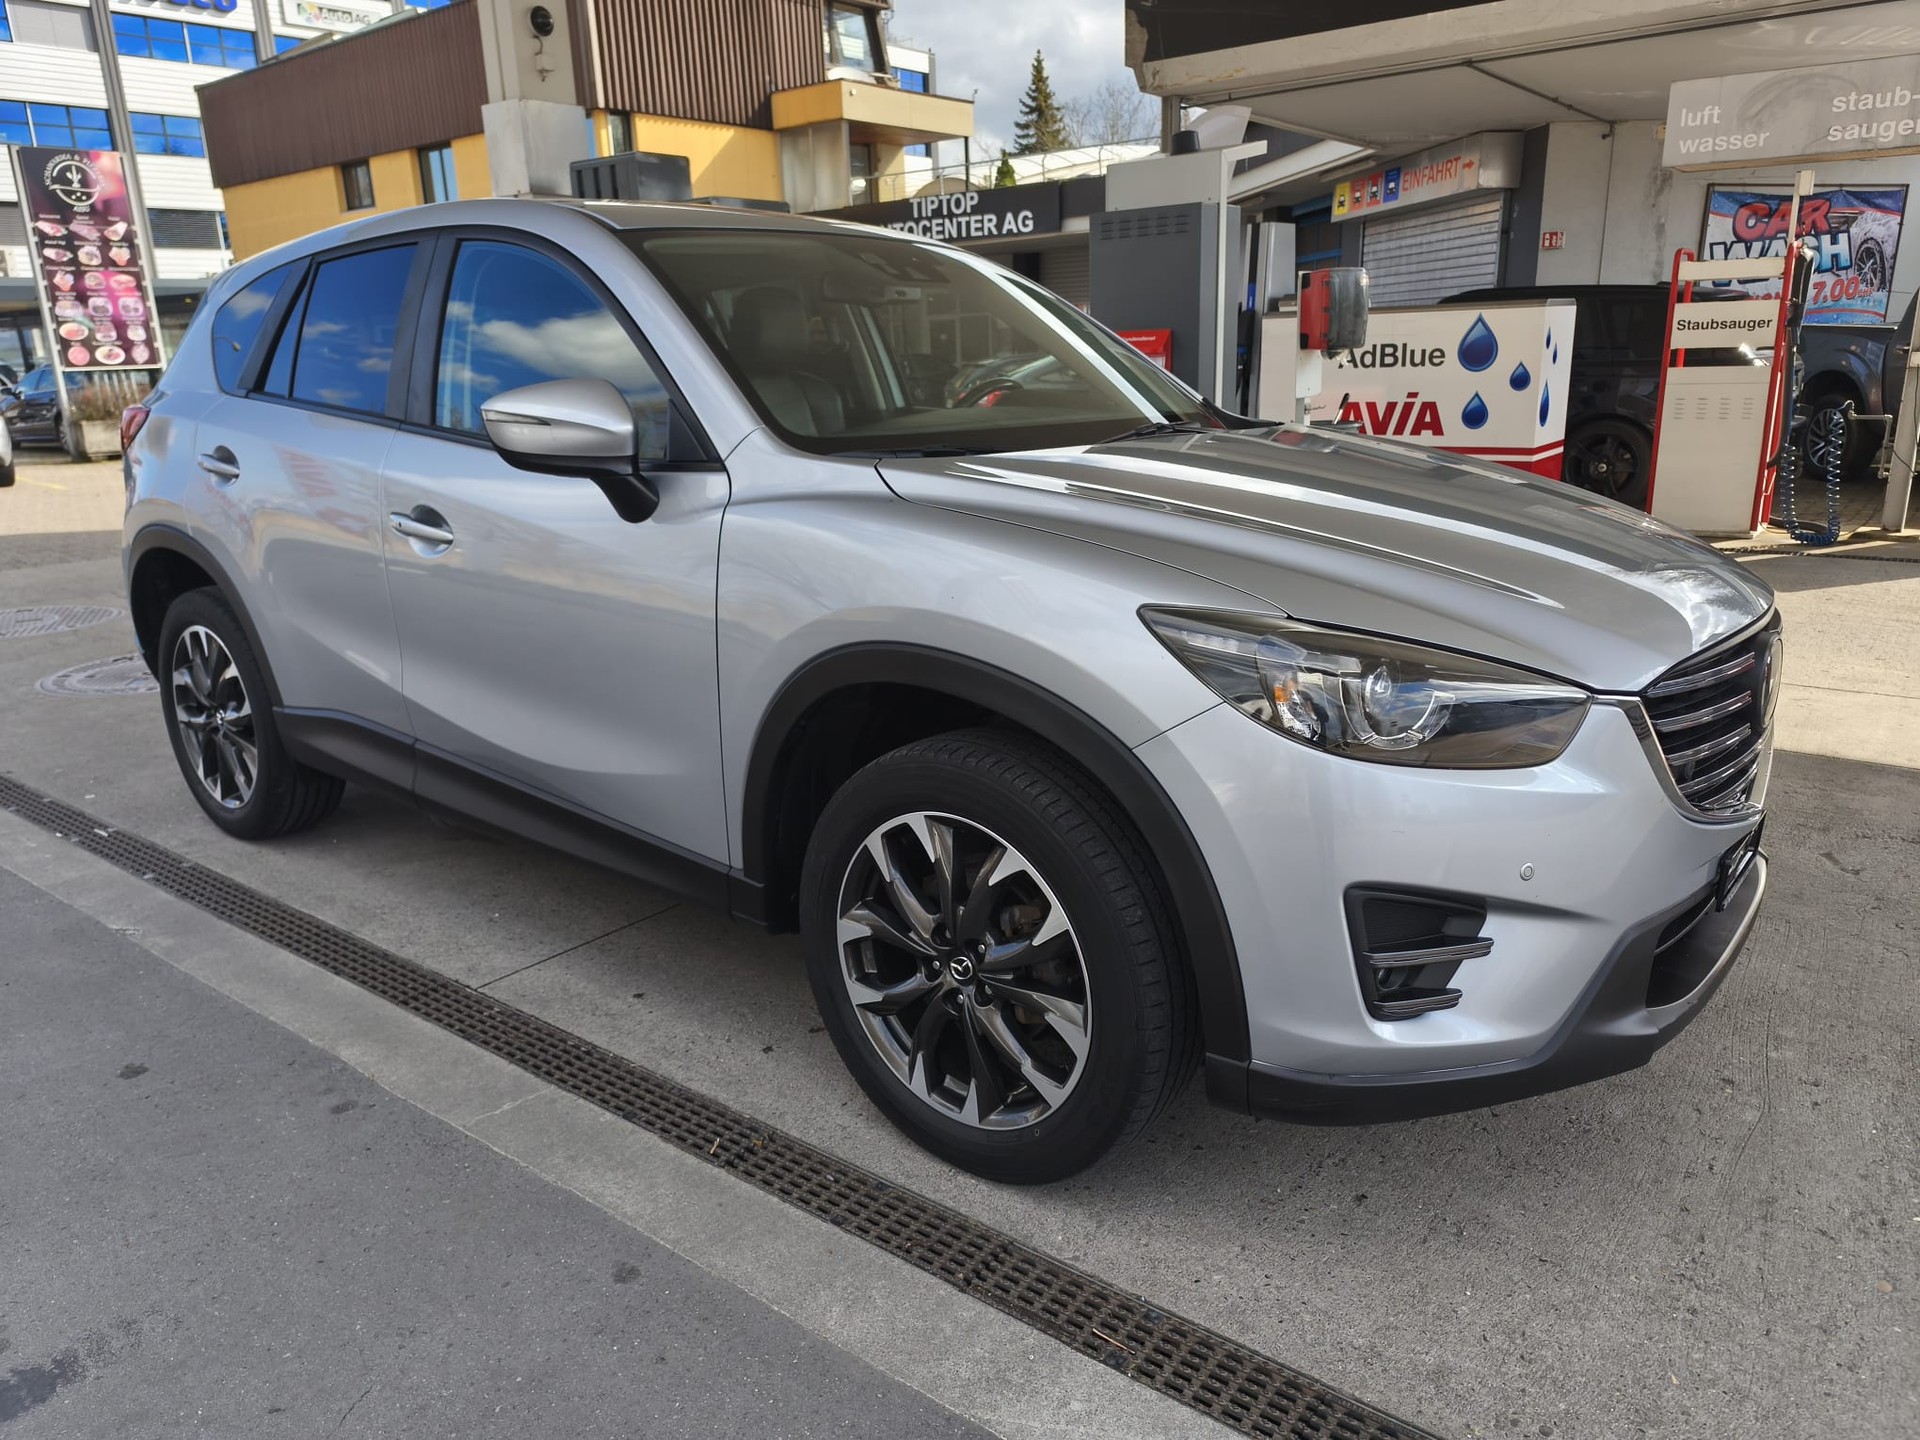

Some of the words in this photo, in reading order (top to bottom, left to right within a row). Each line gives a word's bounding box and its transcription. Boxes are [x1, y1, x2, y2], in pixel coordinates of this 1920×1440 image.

[1680, 105, 1721, 127] luft
[1679, 131, 1770, 154] wasser
[1402, 156, 1461, 193] EINFAHRT
[909, 192, 979, 218] TIPTOP
[880, 213, 998, 240] TOCENTER
[1002, 210, 1034, 234] AG
[1733, 198, 1831, 240] CAR
[1812, 276, 1860, 304] 7.00
[1677, 319, 1773, 332] Staubsauger
